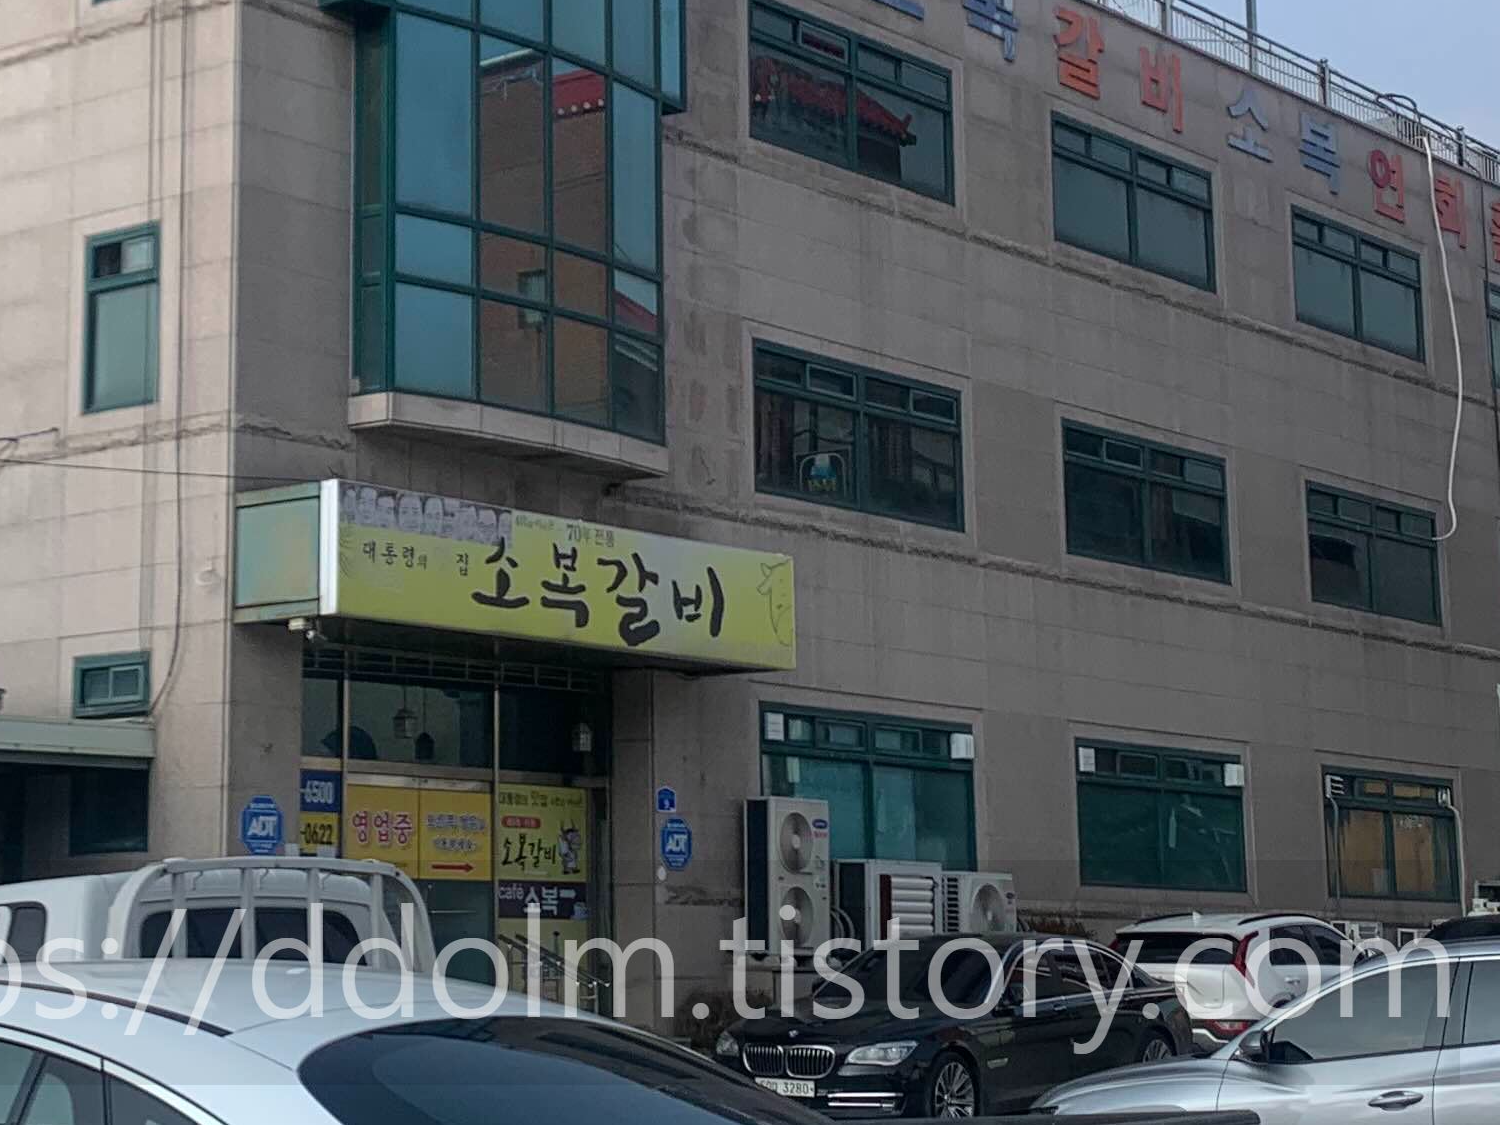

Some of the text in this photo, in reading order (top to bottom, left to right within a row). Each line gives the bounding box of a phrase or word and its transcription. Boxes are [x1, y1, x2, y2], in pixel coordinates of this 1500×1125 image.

[362, 539, 428, 570] 대통령의
[471, 536, 725, 647] 소복갈비
[247, 816, 279, 837] ADT
[352, 810, 413, 845] 영업중
[501, 832, 557, 871] 소복갈비
[666, 833, 688, 853] ADT
[524, 885, 559, 916] 소복
[782, 1081, 809, 1094] 3280
